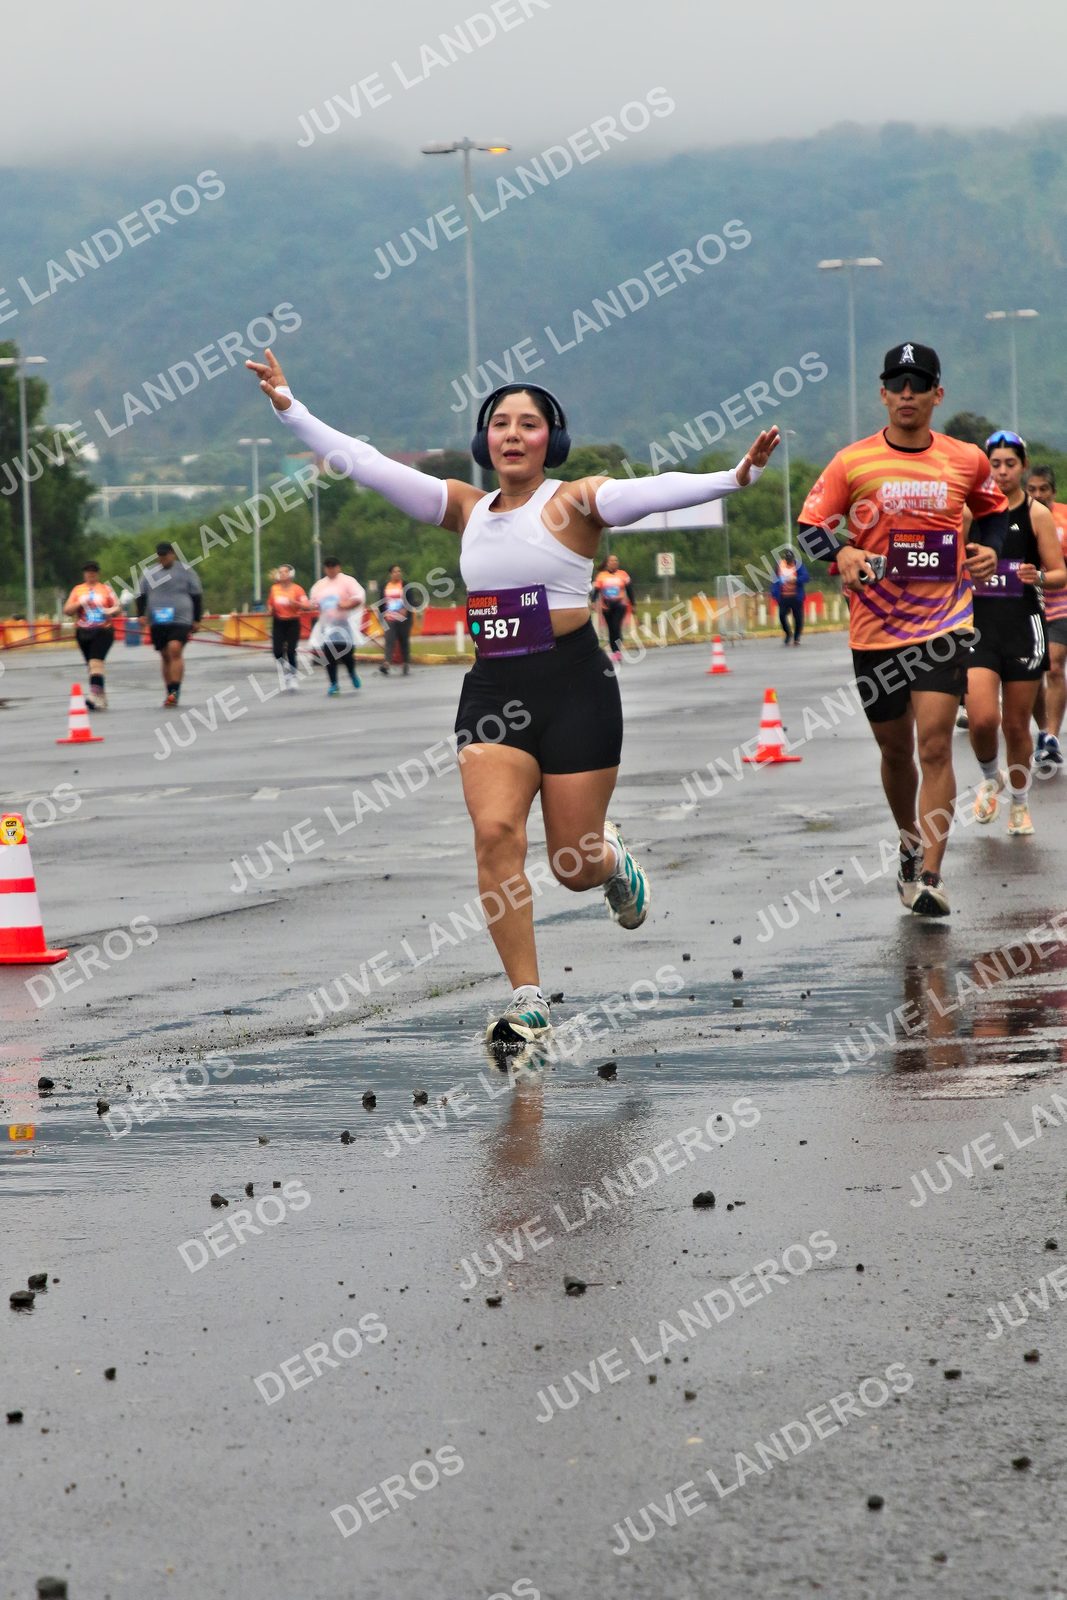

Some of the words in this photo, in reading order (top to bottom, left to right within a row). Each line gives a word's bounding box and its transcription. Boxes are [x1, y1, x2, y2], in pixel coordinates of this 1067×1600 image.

[882, 480, 948, 498] CARRERA
[907, 552, 939, 567] 596
[985, 575, 1007, 587] 51
[520, 592, 538, 607] 15K
[484, 618, 520, 639] 587
